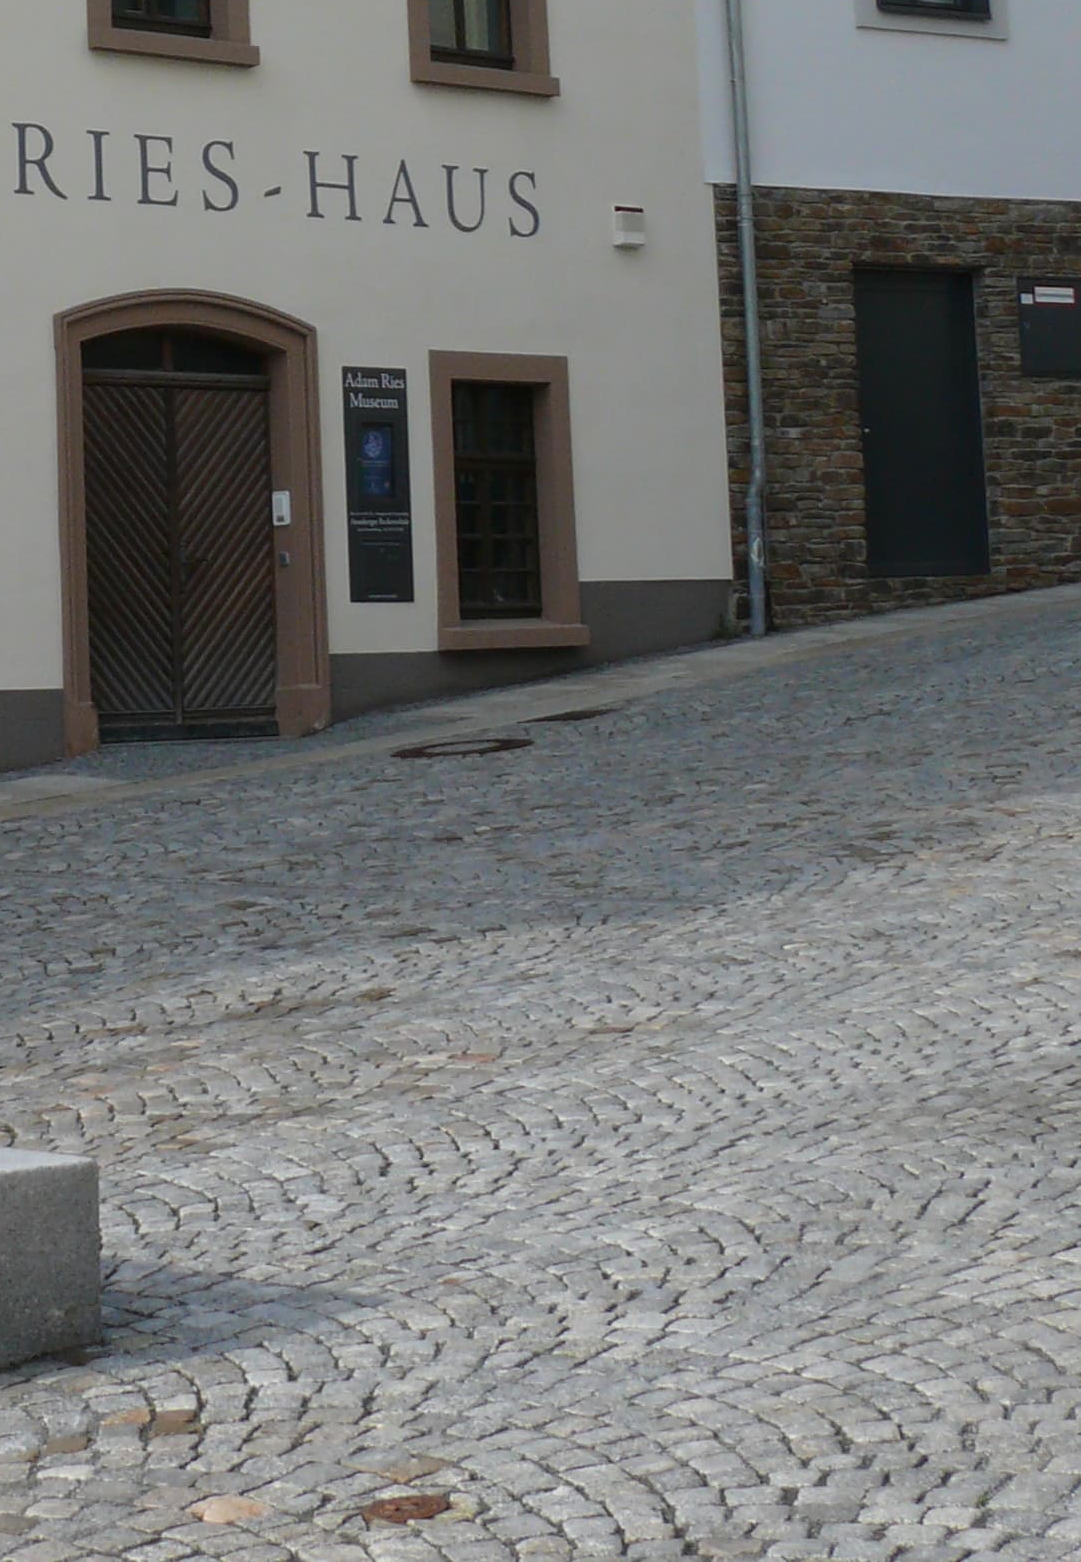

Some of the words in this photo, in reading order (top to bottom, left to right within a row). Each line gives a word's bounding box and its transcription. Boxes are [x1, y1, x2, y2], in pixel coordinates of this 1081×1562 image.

[343, 371, 379, 389] Adam
[380, 373, 405, 389] Ries
[349, 392, 399, 409] Museum
